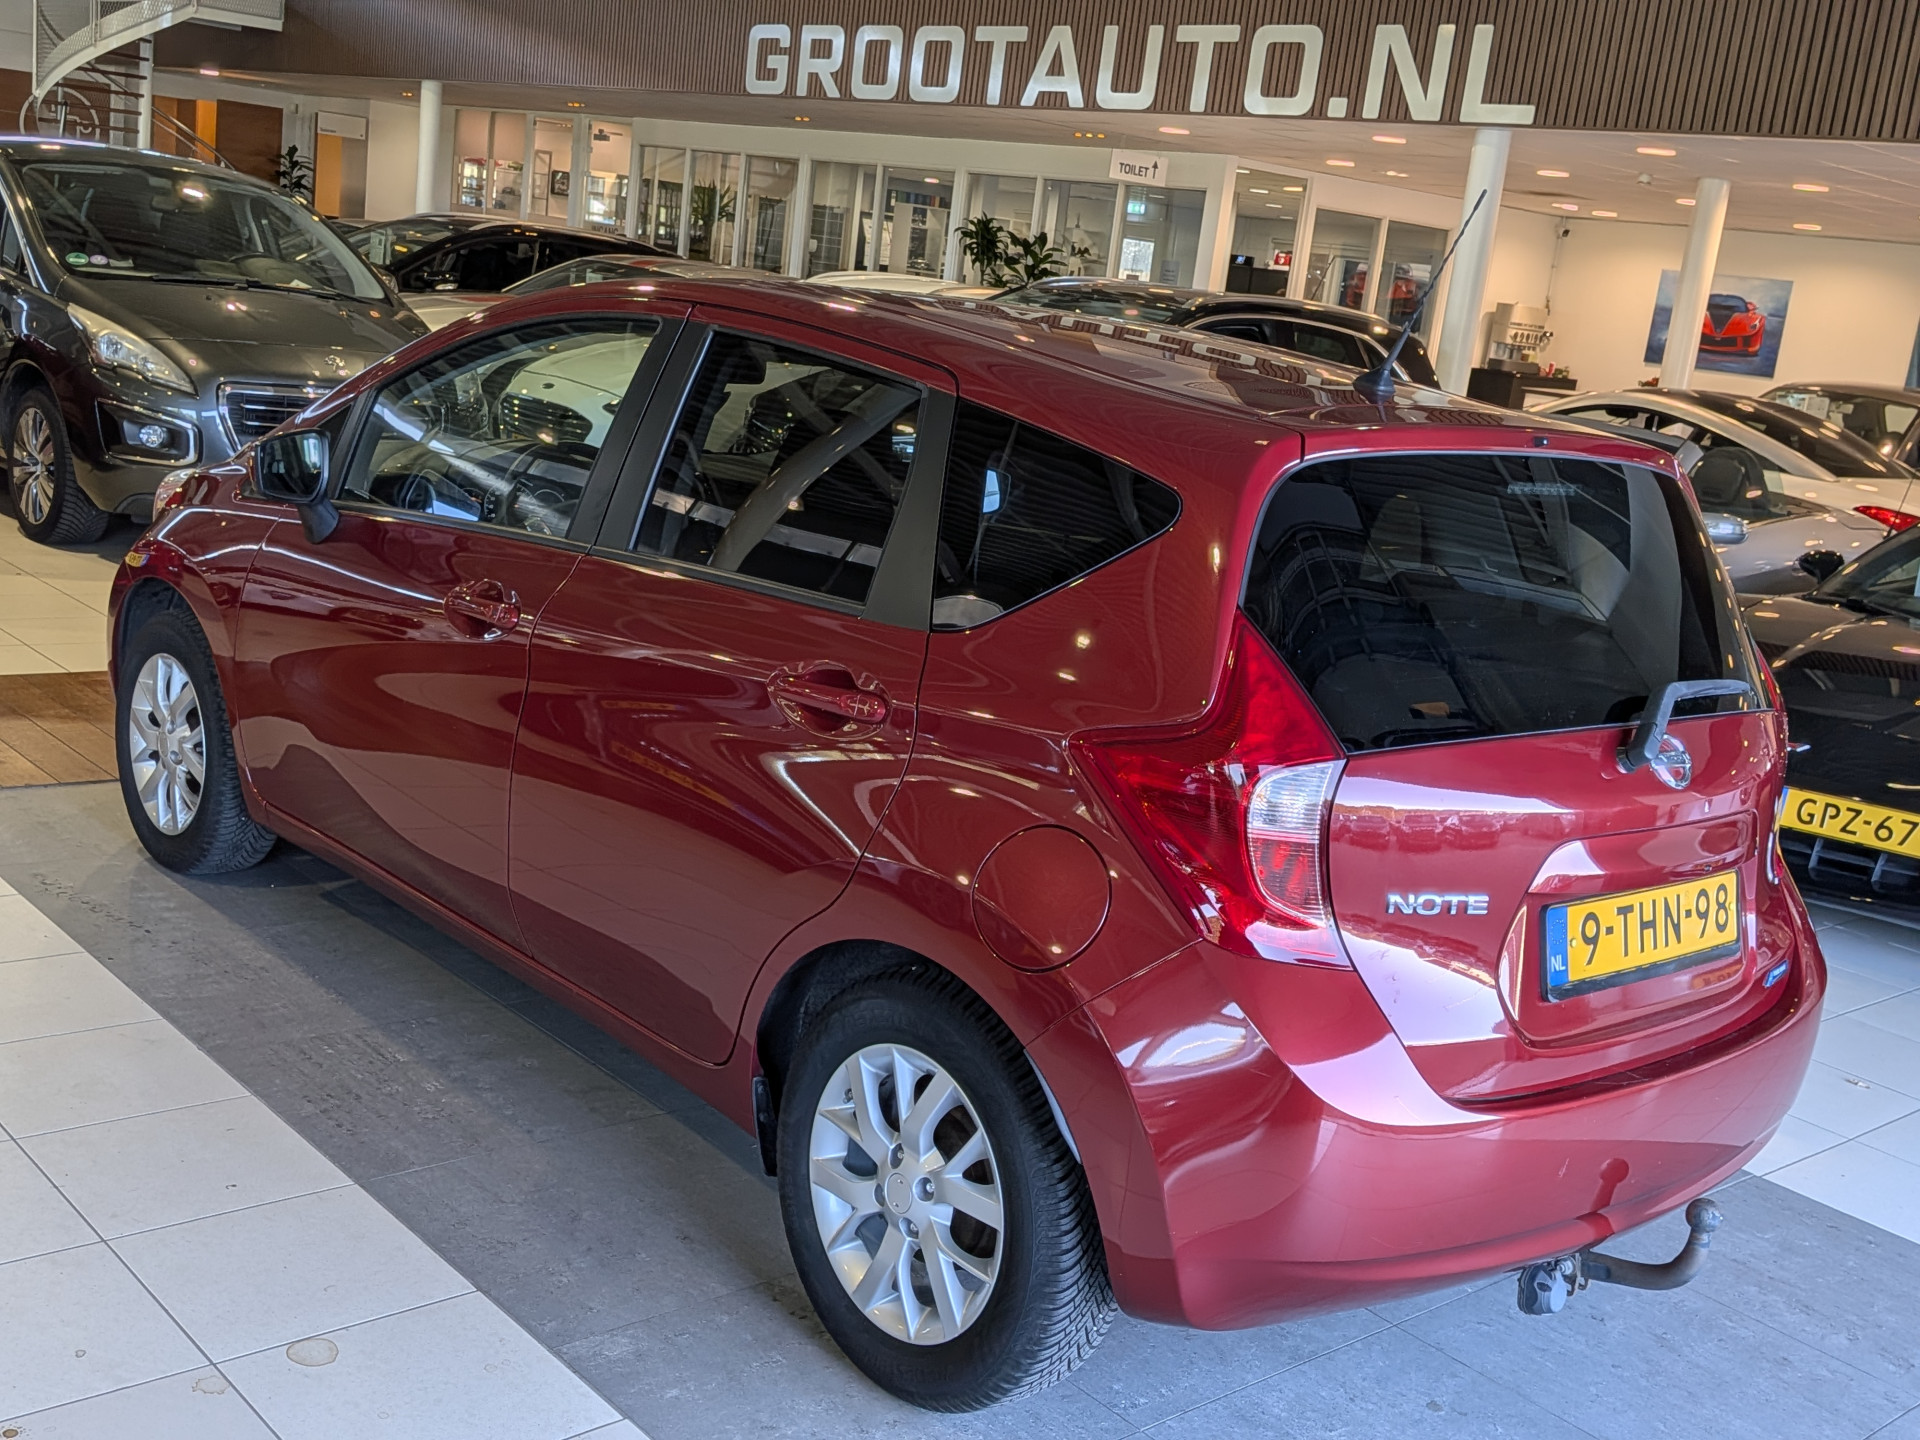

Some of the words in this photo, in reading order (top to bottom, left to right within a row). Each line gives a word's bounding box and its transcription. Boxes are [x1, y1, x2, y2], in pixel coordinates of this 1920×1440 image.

[745, 23, 1536, 126] GROOTAUTO.NL
[1119, 162, 1150, 178] TOILET
[1796, 798, 1920, 847] GPZ-67
[1386, 893, 1490, 916] NOTE
[1580, 883, 1729, 966] 9-THN-98
[1551, 954, 1566, 972] NL
